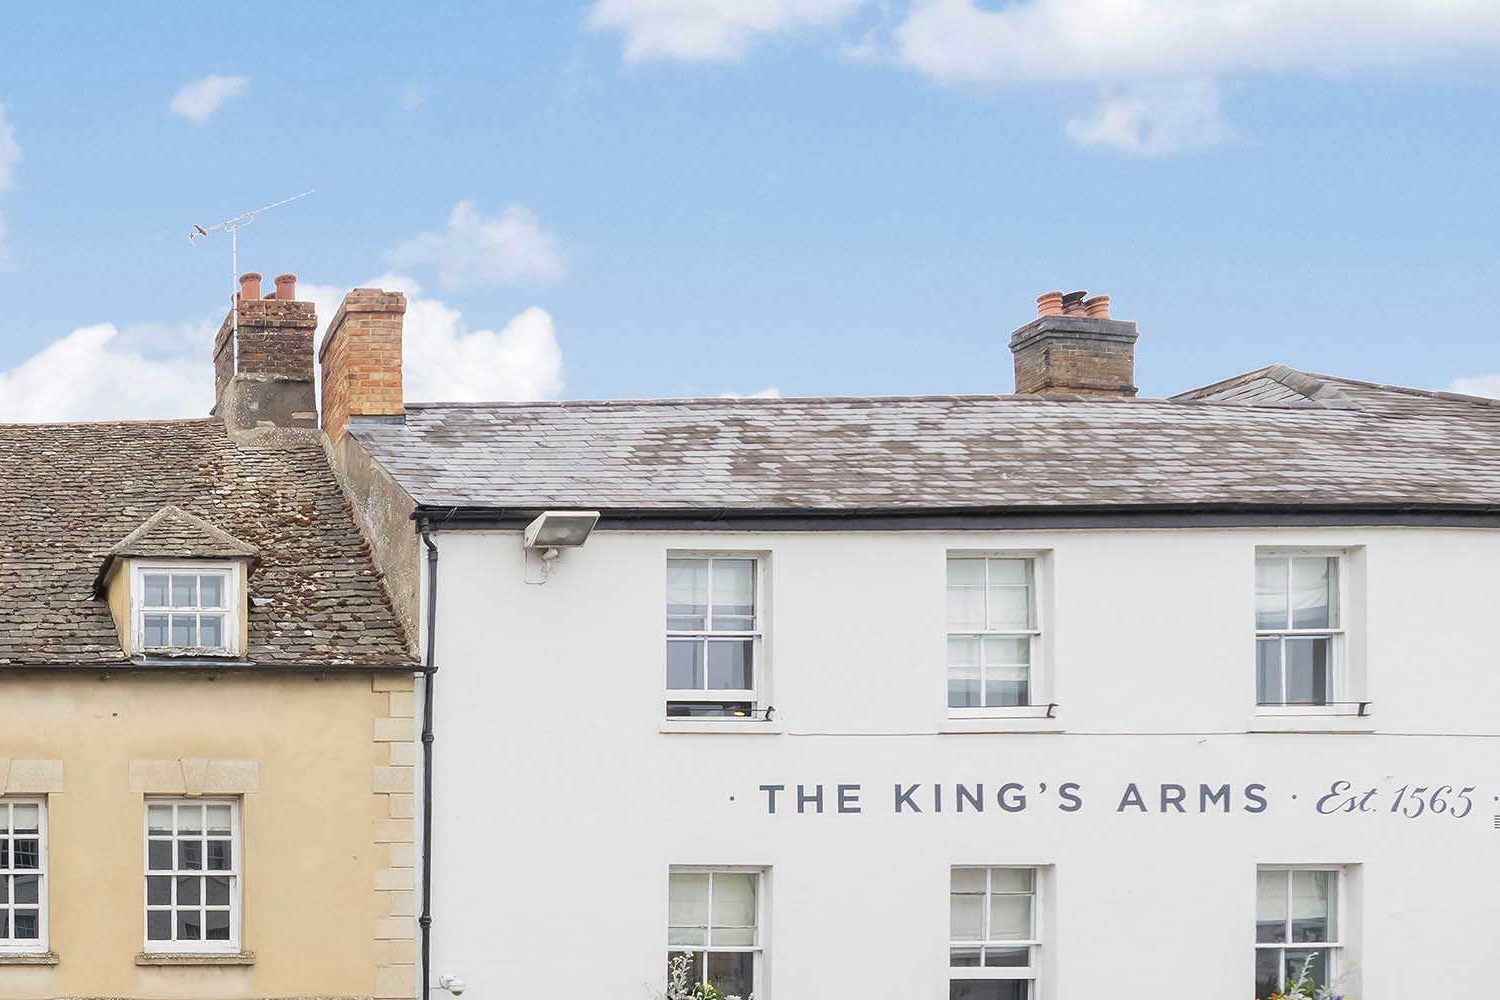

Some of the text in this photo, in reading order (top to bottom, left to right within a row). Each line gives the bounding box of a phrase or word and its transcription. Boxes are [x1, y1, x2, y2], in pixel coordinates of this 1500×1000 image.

[758, 780, 1476, 820] THE KING'S ARMS Est. 1565
